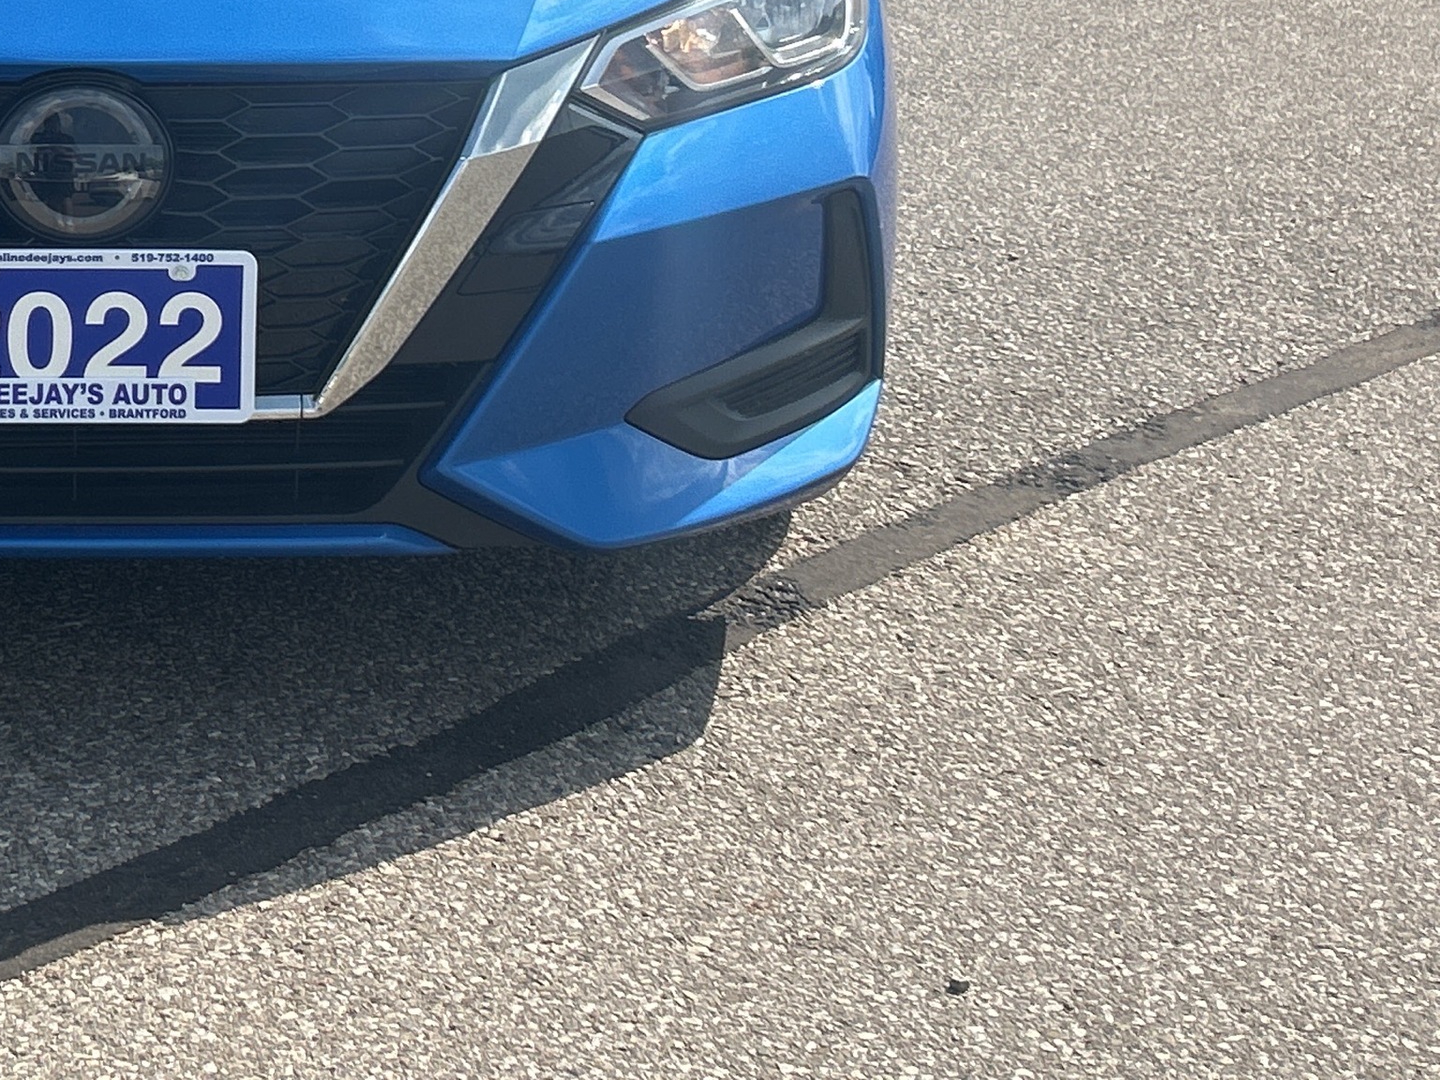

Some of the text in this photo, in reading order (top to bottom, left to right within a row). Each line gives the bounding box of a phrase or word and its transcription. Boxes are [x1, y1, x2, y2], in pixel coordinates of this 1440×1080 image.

[15, 152, 147, 173] NISSAN
[131, 252, 215, 263] 519-752-1400
[112, 383, 188, 405] AUTO
[19, 408, 29, 419] &
[32, 408, 96, 419] SERVICES
[109, 408, 187, 419] BRANTFORD
